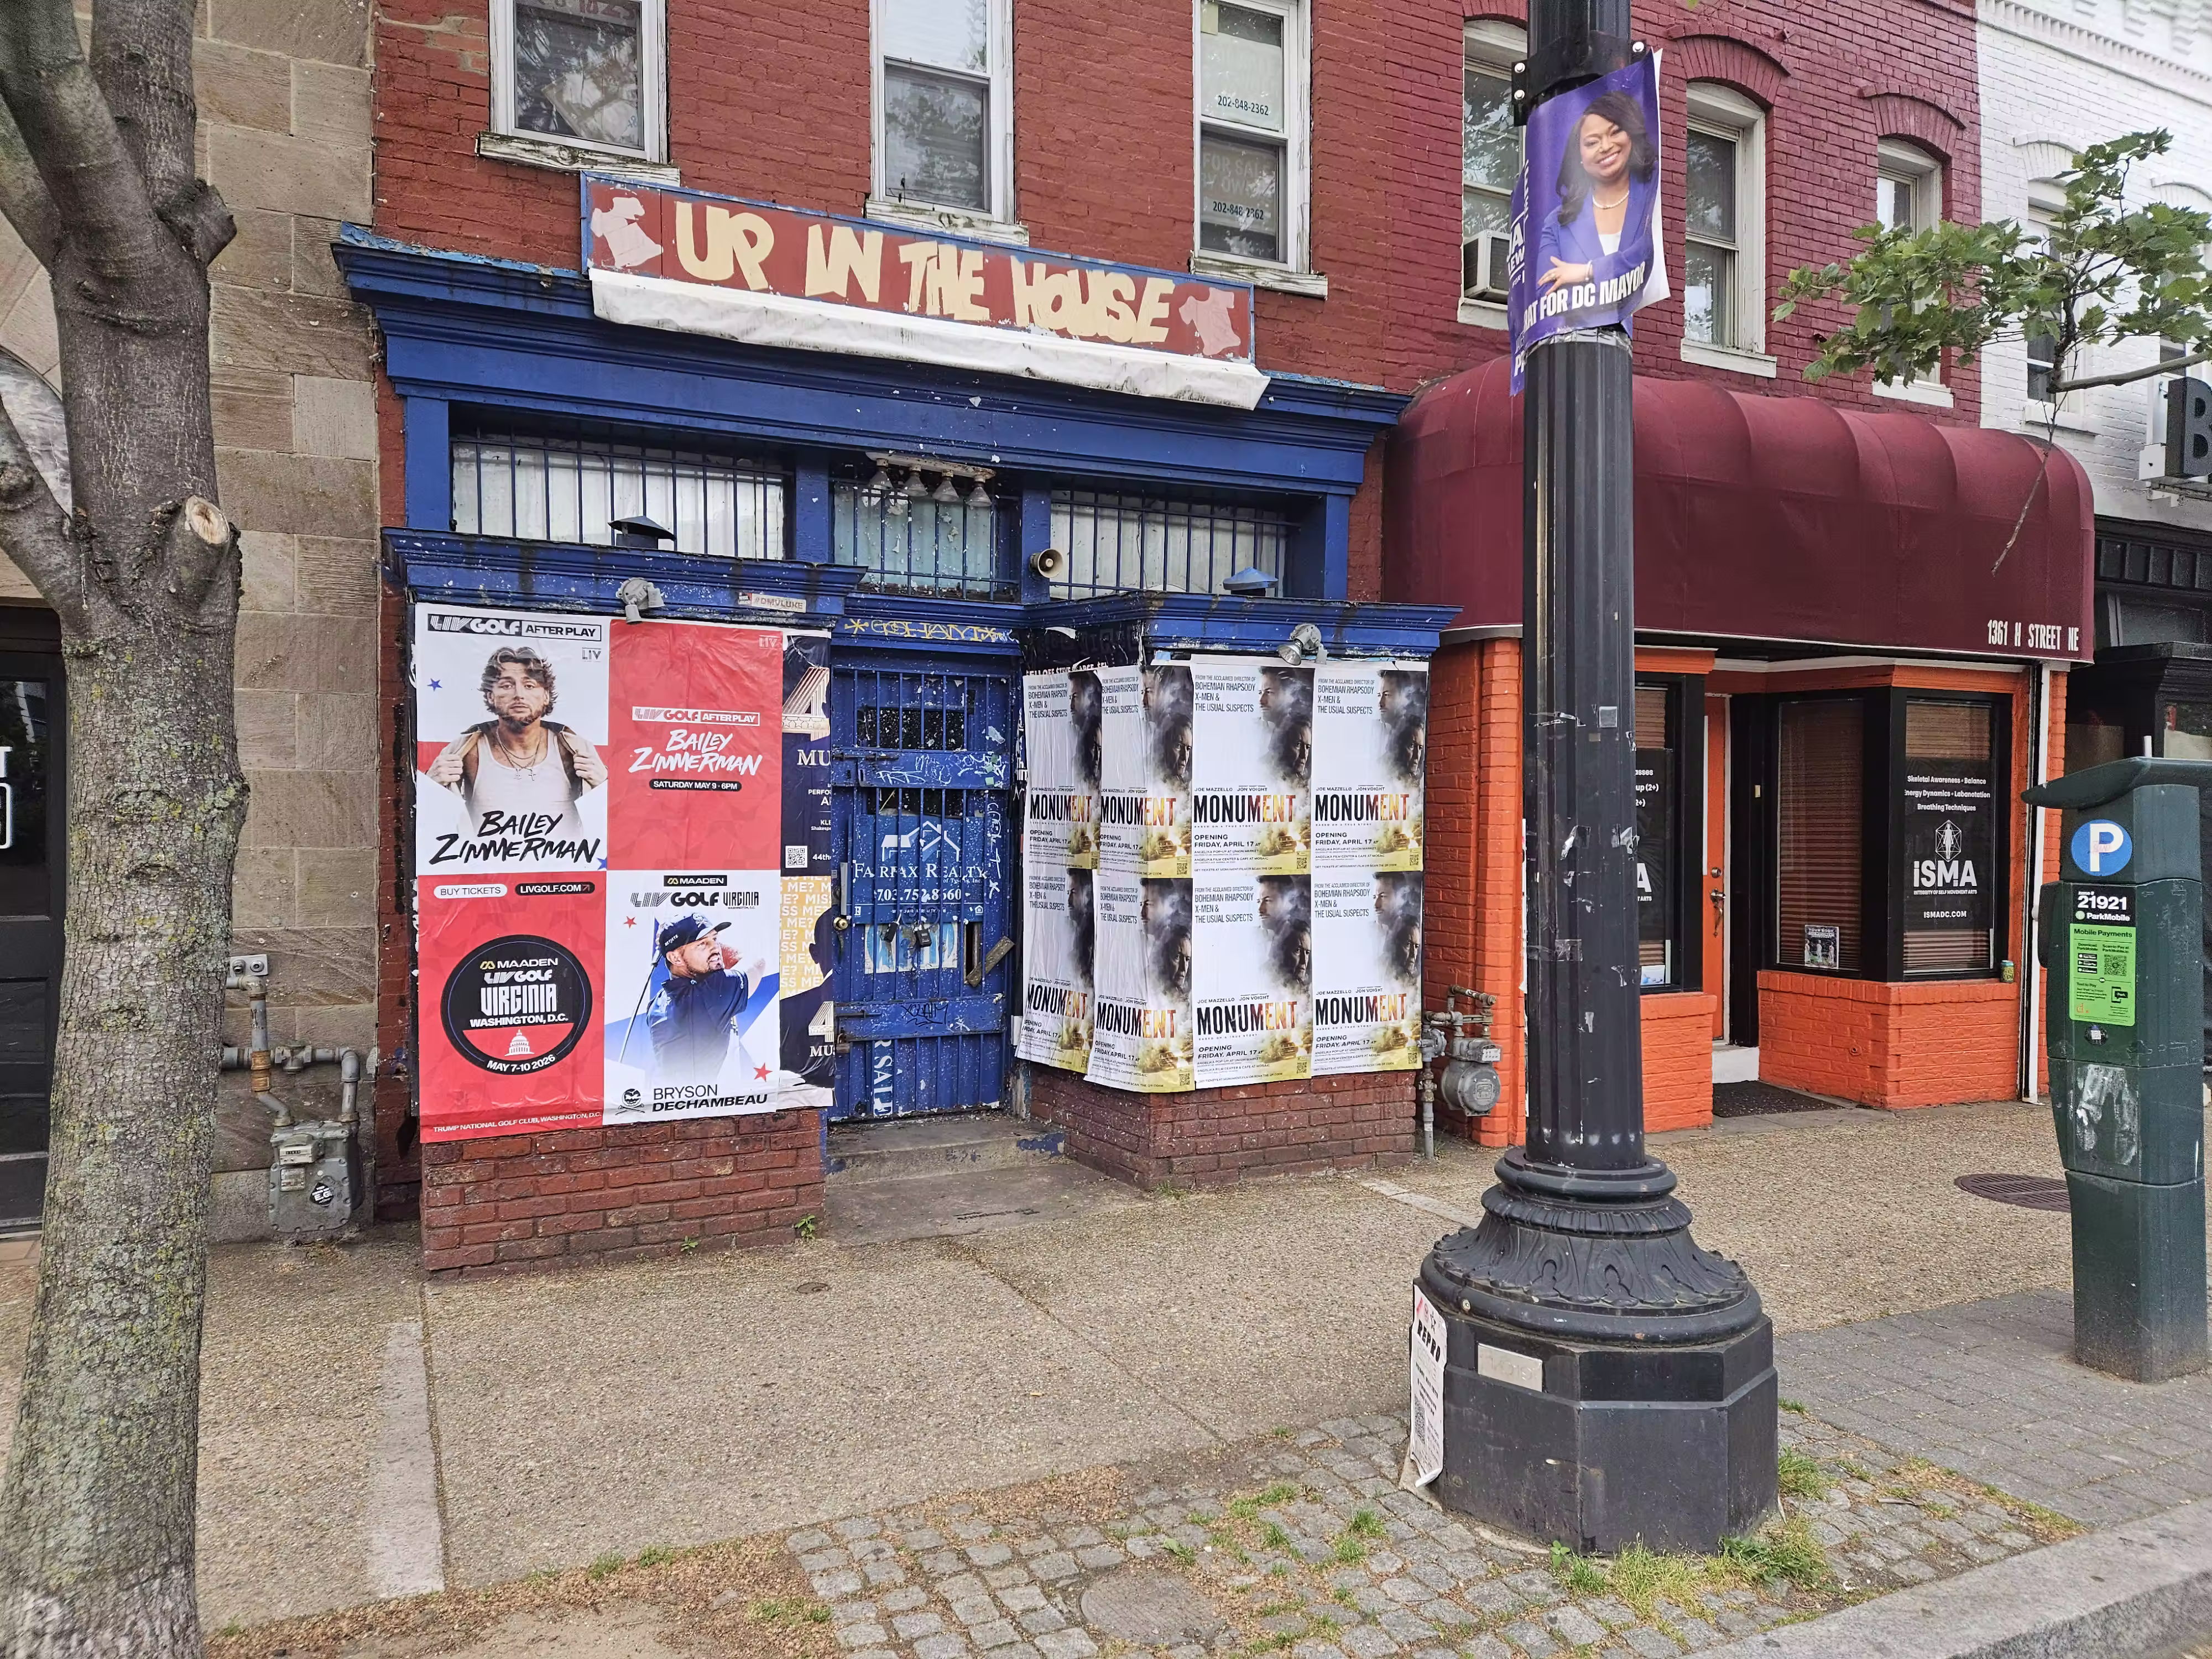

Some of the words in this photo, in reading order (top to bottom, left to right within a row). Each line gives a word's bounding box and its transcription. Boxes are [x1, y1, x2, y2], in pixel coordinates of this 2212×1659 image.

[1218, 96, 1269, 116] 202-848-2362
[805, 223, 883, 302] IN
[898, 241, 989, 321] THE
[1010, 255, 1175, 343] HOUSE
[1540, 289, 1568, 320] FOR
[1572, 283, 1595, 310] DC
[1599, 261, 1646, 305] MAYOR
[470, 618, 521, 635] GOLF
[525, 625, 564, 637] AFTER
[565, 627, 597, 638] PLAY
[1987, 620, 2008, 645] 1361
[2015, 622, 2021, 646] H
[2028, 624, 2062, 650] STREET
[2068, 627, 2079, 651] NE
[582, 648, 602, 661] LIV
[1196, 682, 1225, 691] BOHEMIAN
[1226, 683, 1255, 691] RHAPSODY
[1195, 692, 1214, 701] X-MEN
[664, 709, 699, 722] GOLF
[1227, 704, 1254, 712] SUSPECTS
[666, 729, 733, 754] BAILEY
[629, 747, 762, 775] ZIMMERMAN
[1030, 794, 1092, 823] MONUMENT
[1102, 796, 1176, 826] MONUMENT
[1194, 795, 1296, 823] MONUMENT
[1315, 794, 1409, 821] MONUMENT
[1917, 804, 1944, 812] Breathing
[1945, 804, 1976, 812] Techniques
[477, 811, 563, 838] BAILEY
[429, 834, 600, 865] ZIMMERMAN
[2089, 823, 2124, 872] P
[462, 887, 501, 895] TICKETS
[520, 885, 581, 894] LIVGOLF.COM
[787, 882, 814, 892] ME?
[671, 892, 719, 907] GOLF
[723, 892, 759, 906] VIRGINIA
[806, 894, 831, 904] MIS
[2078, 895, 2127, 910] 21921
[2086, 912, 2130, 921] ParkMobile
[498, 958, 558, 968] MAADEN
[514, 969, 552, 982] GOLF
[481, 984, 557, 1016] VIRGINIA
[1027, 983, 1087, 1020] MONUMENT
[1197, 1001, 1297, 1035] MONUMENT
[1316, 993, 1406, 1026] MONUMENT
[470, 1015, 546, 1027] WASHINGTON,
[547, 1014, 568, 1022] D.C.
[1096, 1001, 1176, 1039] MONUMENT
[487, 1061, 510, 1072] MAY
[511, 1063, 530, 1072] 7-10
[531, 1055, 556, 1069] 2026
[653, 1084, 718, 1100] BRYSON
[653, 1094, 768, 1112] DECHAMBEAU
[540, 1113, 588, 1123] WASHINGTON,
